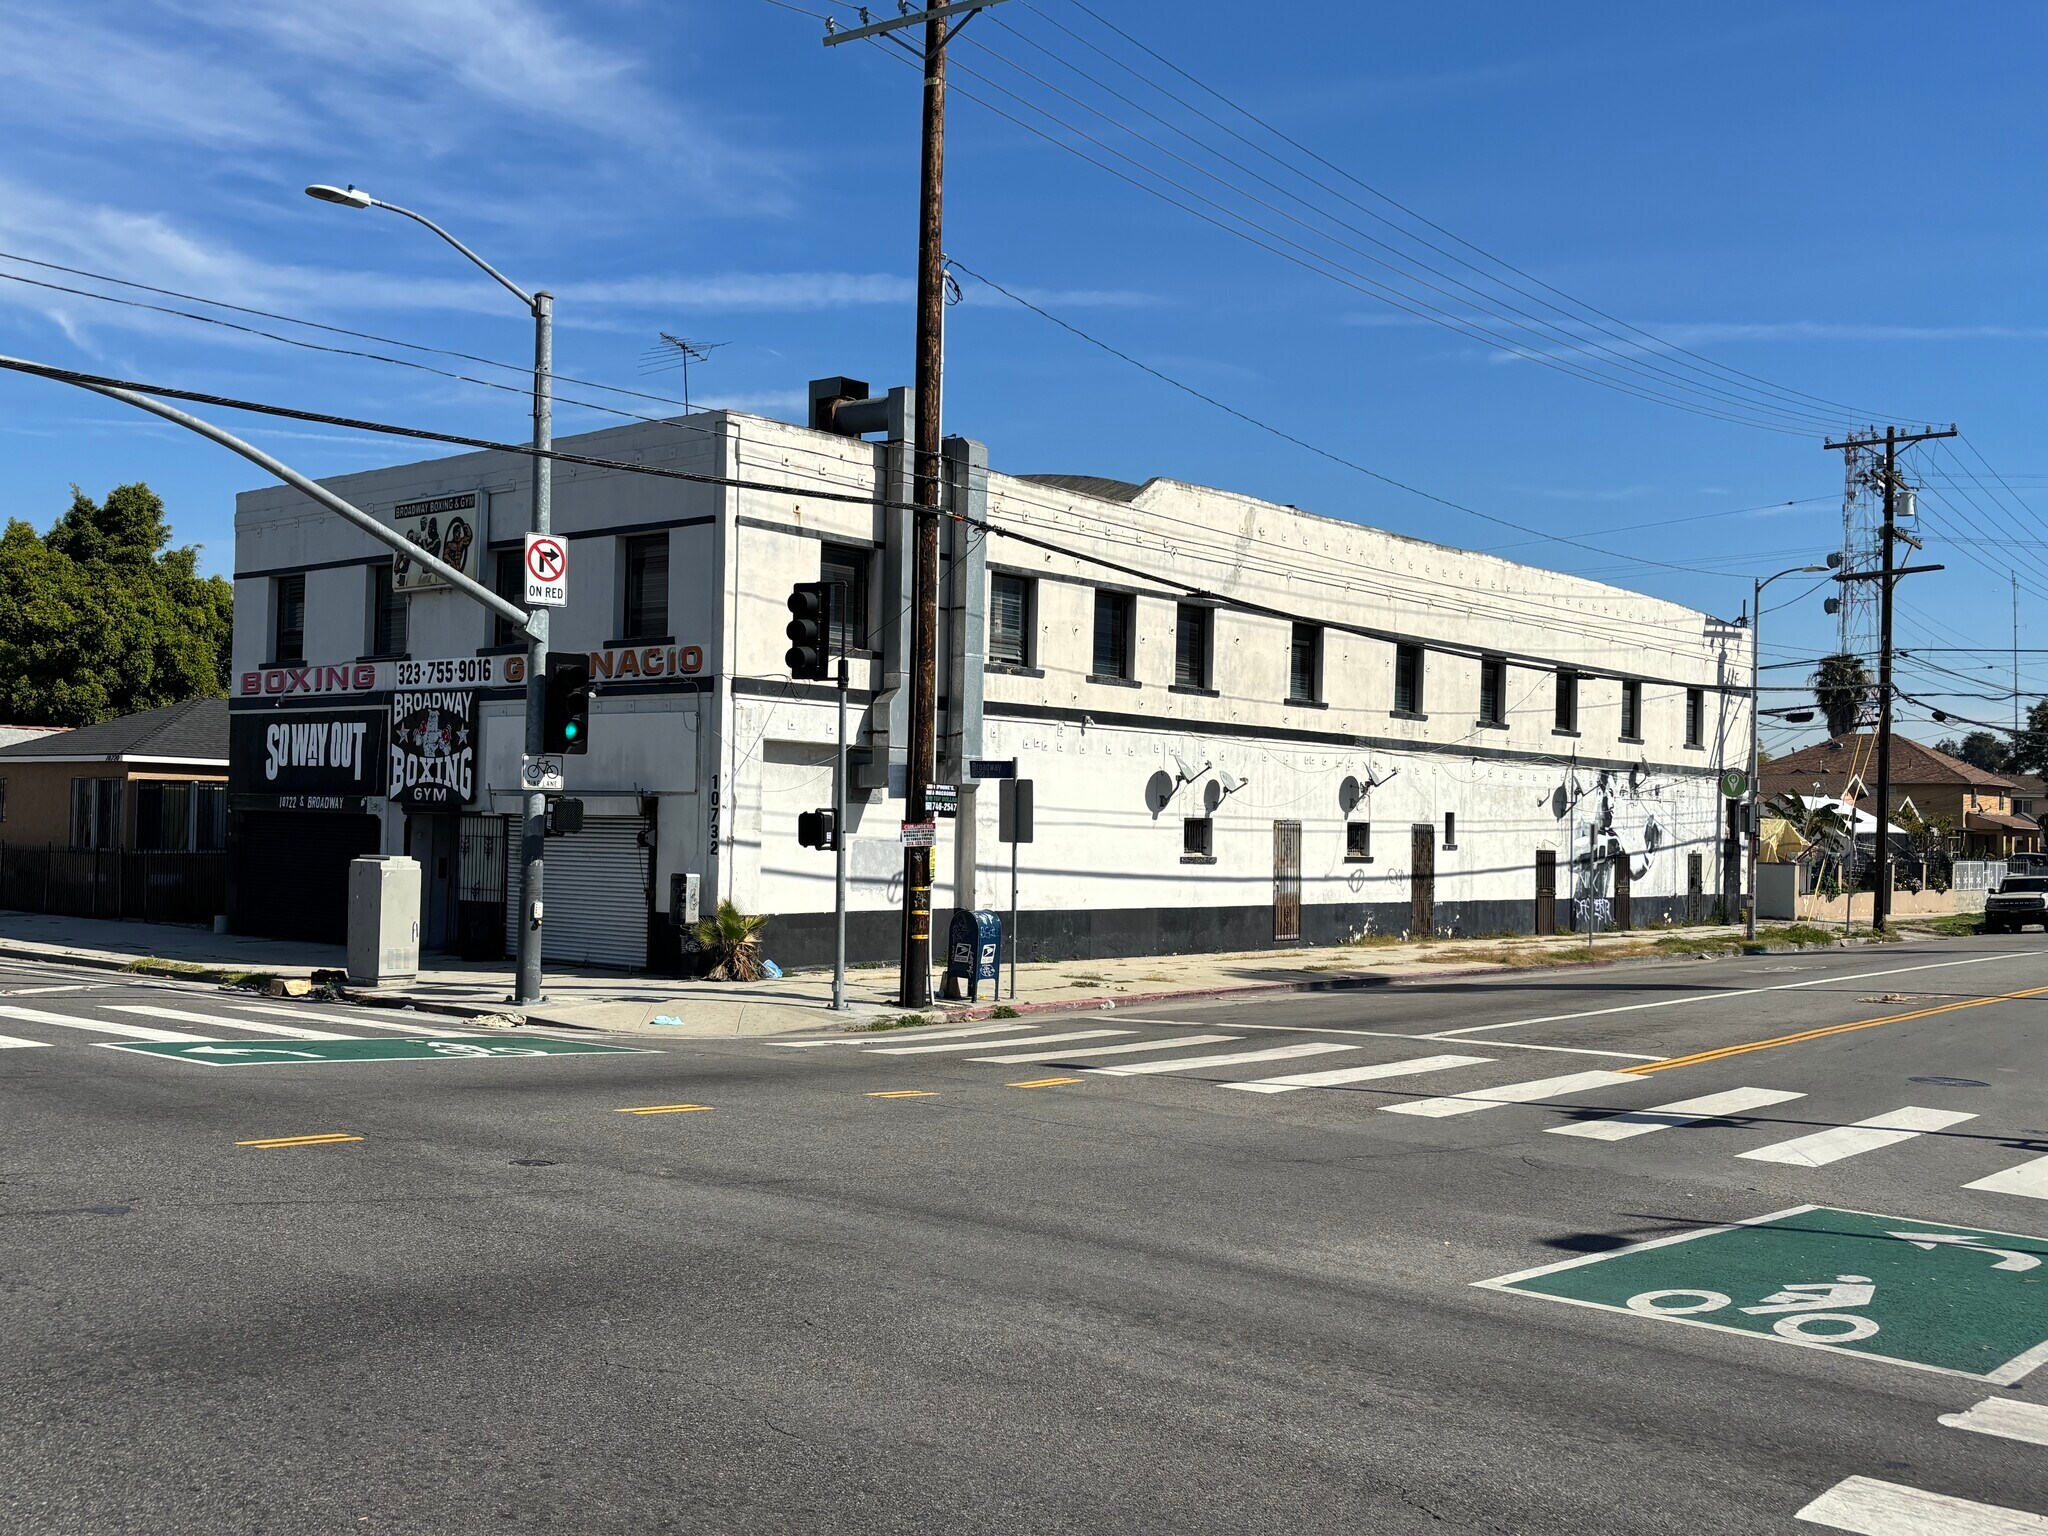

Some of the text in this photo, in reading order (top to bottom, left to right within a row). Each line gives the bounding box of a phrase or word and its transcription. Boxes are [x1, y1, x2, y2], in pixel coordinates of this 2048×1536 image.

[396, 495, 475, 518] BROADWAY BOXING & GYM
[529, 585, 563, 599] ON RED
[241, 664, 376, 696] BOXING
[393, 691, 473, 726] BROADWAY
[265, 721, 367, 780] SO WAY OUT
[389, 743, 473, 801] BOXING
[413, 787, 447, 801] GYM
[542, 780, 558, 788] LANE
[307, 796, 345, 809] BROADWAY
